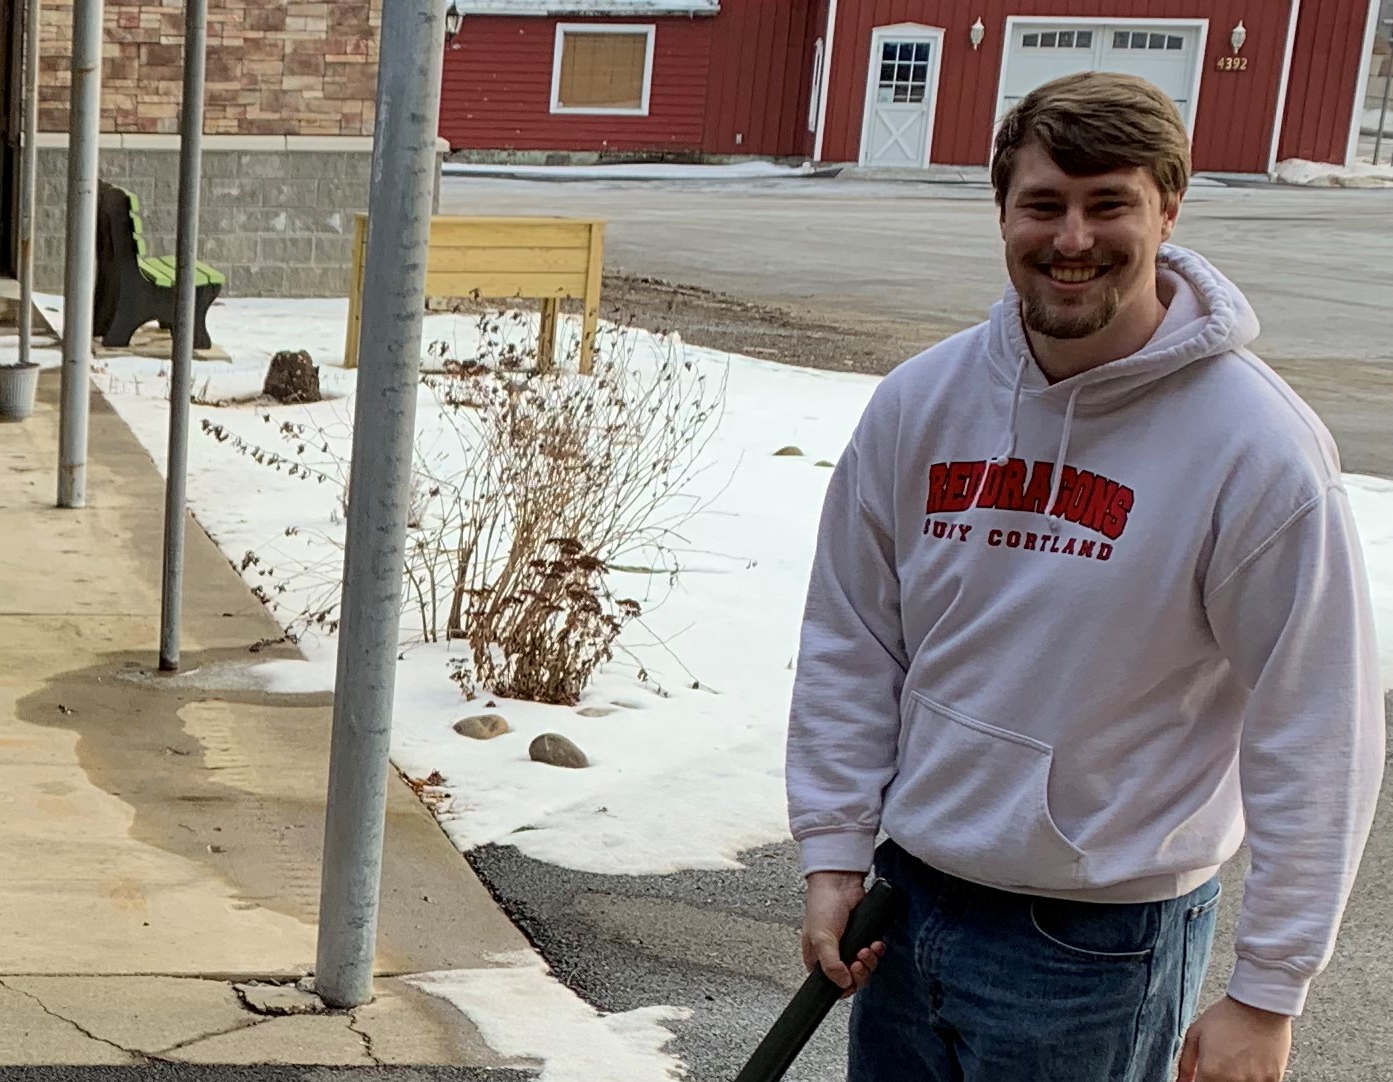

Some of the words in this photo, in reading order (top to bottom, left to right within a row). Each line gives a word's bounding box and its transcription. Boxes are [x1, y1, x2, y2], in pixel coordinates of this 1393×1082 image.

[1217, 57, 1248, 71] 4392
[976, 457, 1135, 541] DRAGONS
[987, 529, 1114, 562] CORTLAND
